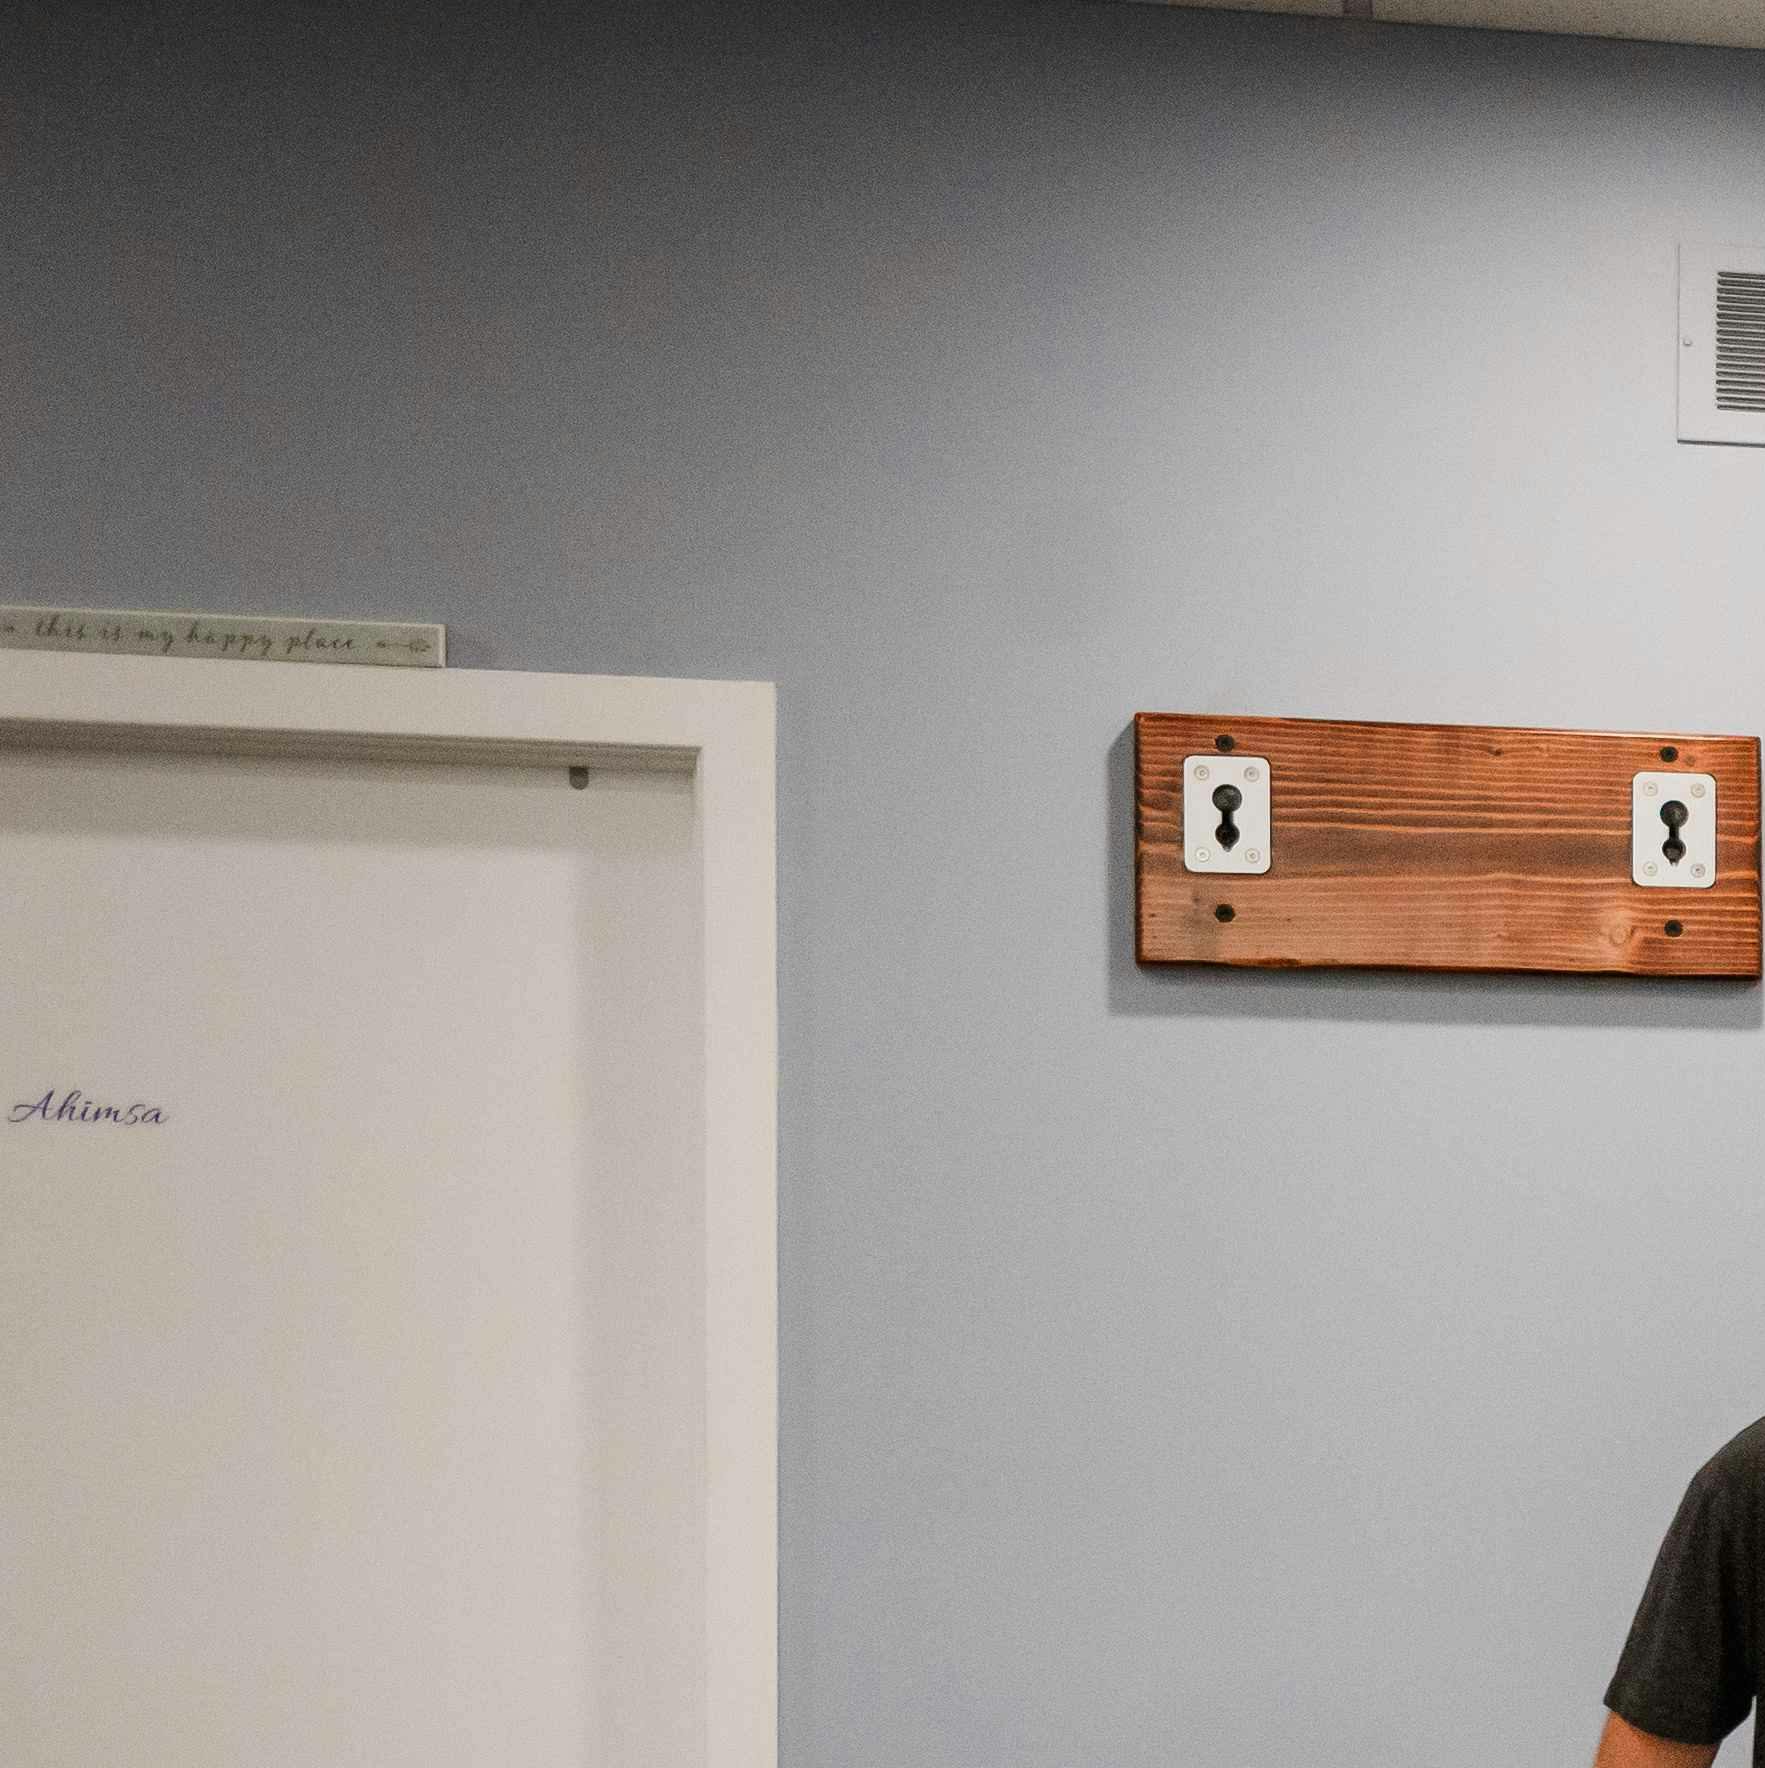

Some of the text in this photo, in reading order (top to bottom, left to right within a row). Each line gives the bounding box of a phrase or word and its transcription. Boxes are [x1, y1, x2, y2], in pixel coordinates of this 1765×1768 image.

[34, 615, 358, 657] this is my happy place
[7, 1088, 170, 1126] Ahimsa
